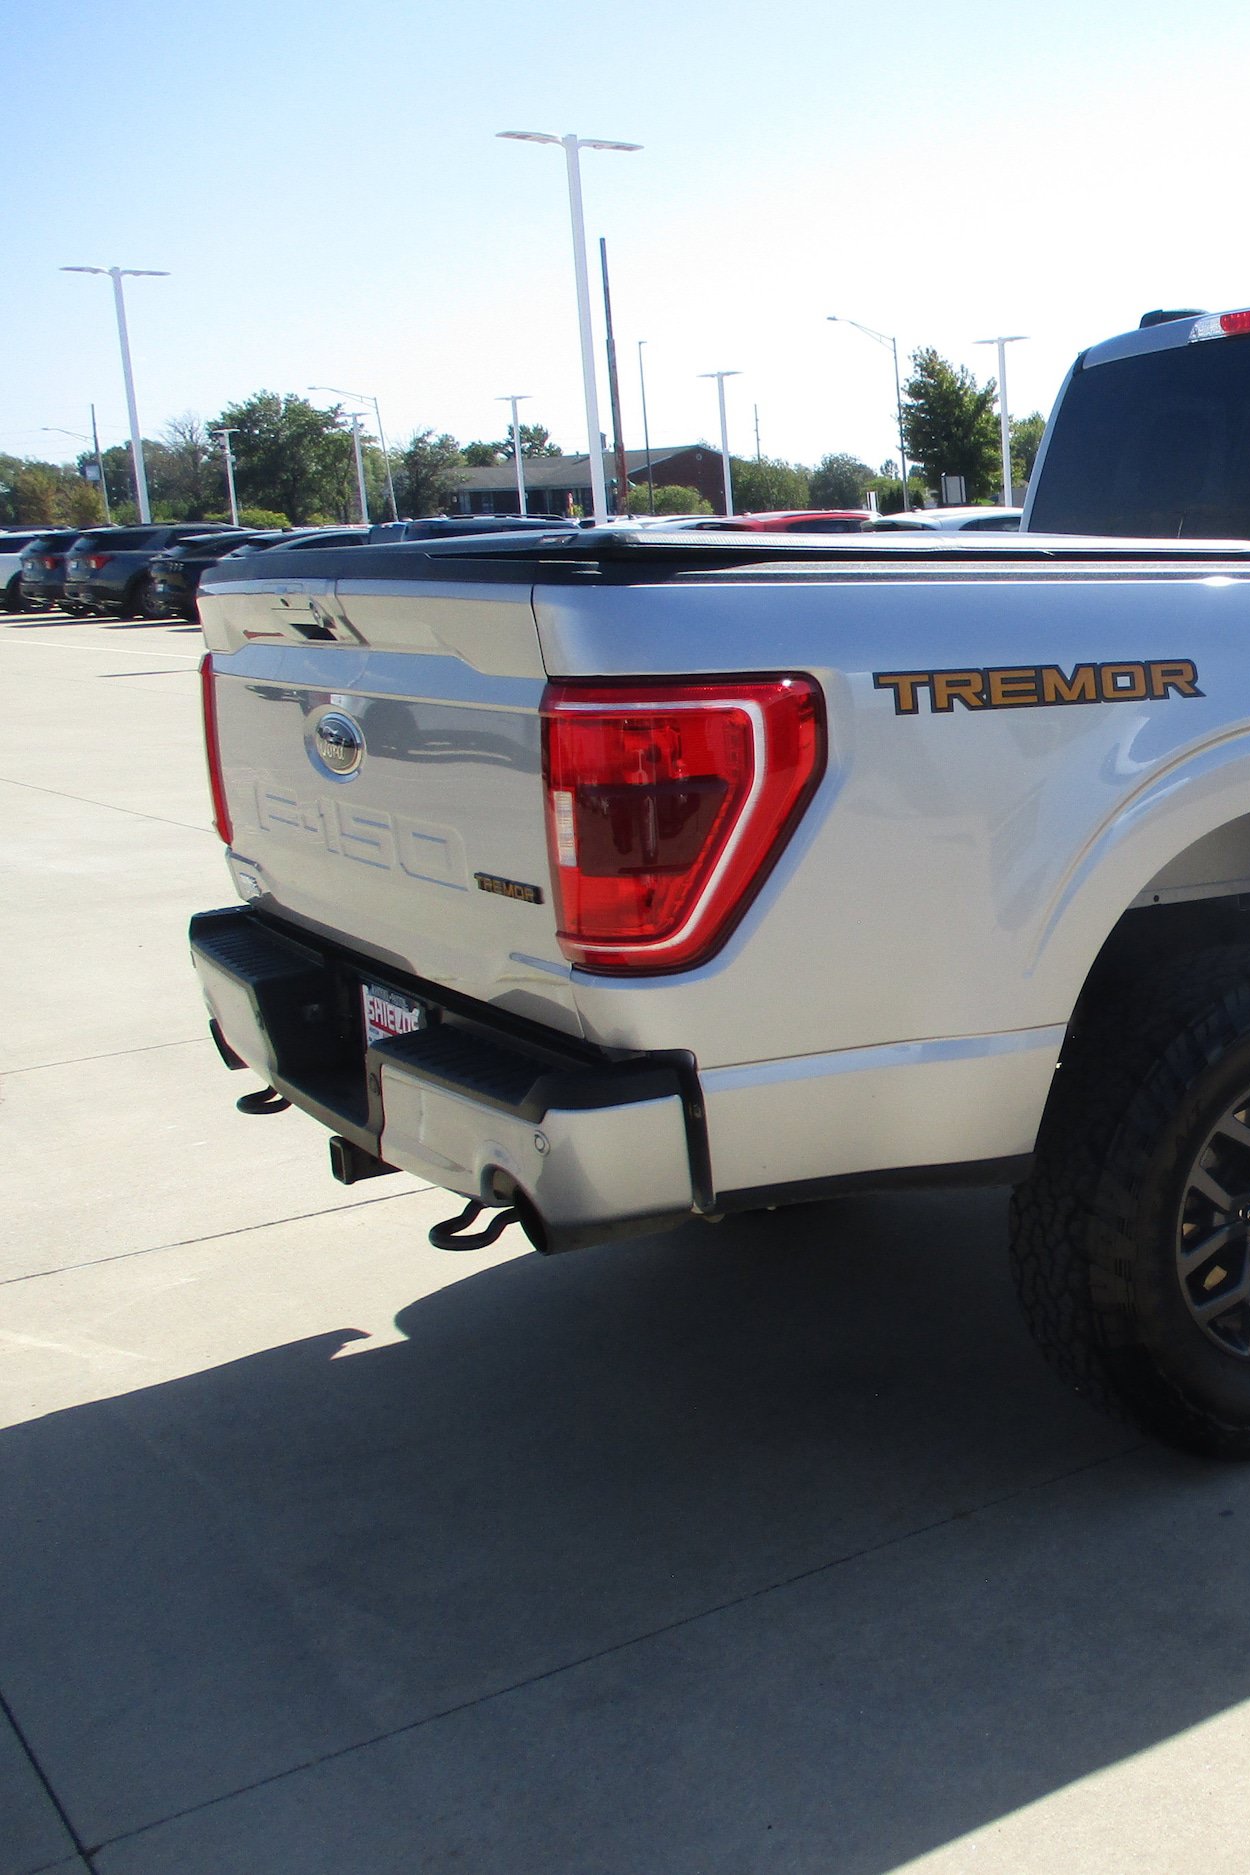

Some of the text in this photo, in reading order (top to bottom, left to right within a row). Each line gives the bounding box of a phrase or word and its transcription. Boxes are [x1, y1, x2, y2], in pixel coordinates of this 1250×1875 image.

[873, 659, 1206, 715] TREMOR
[254, 781, 470, 892] F-150
[474, 873, 538, 903] TREMOR
